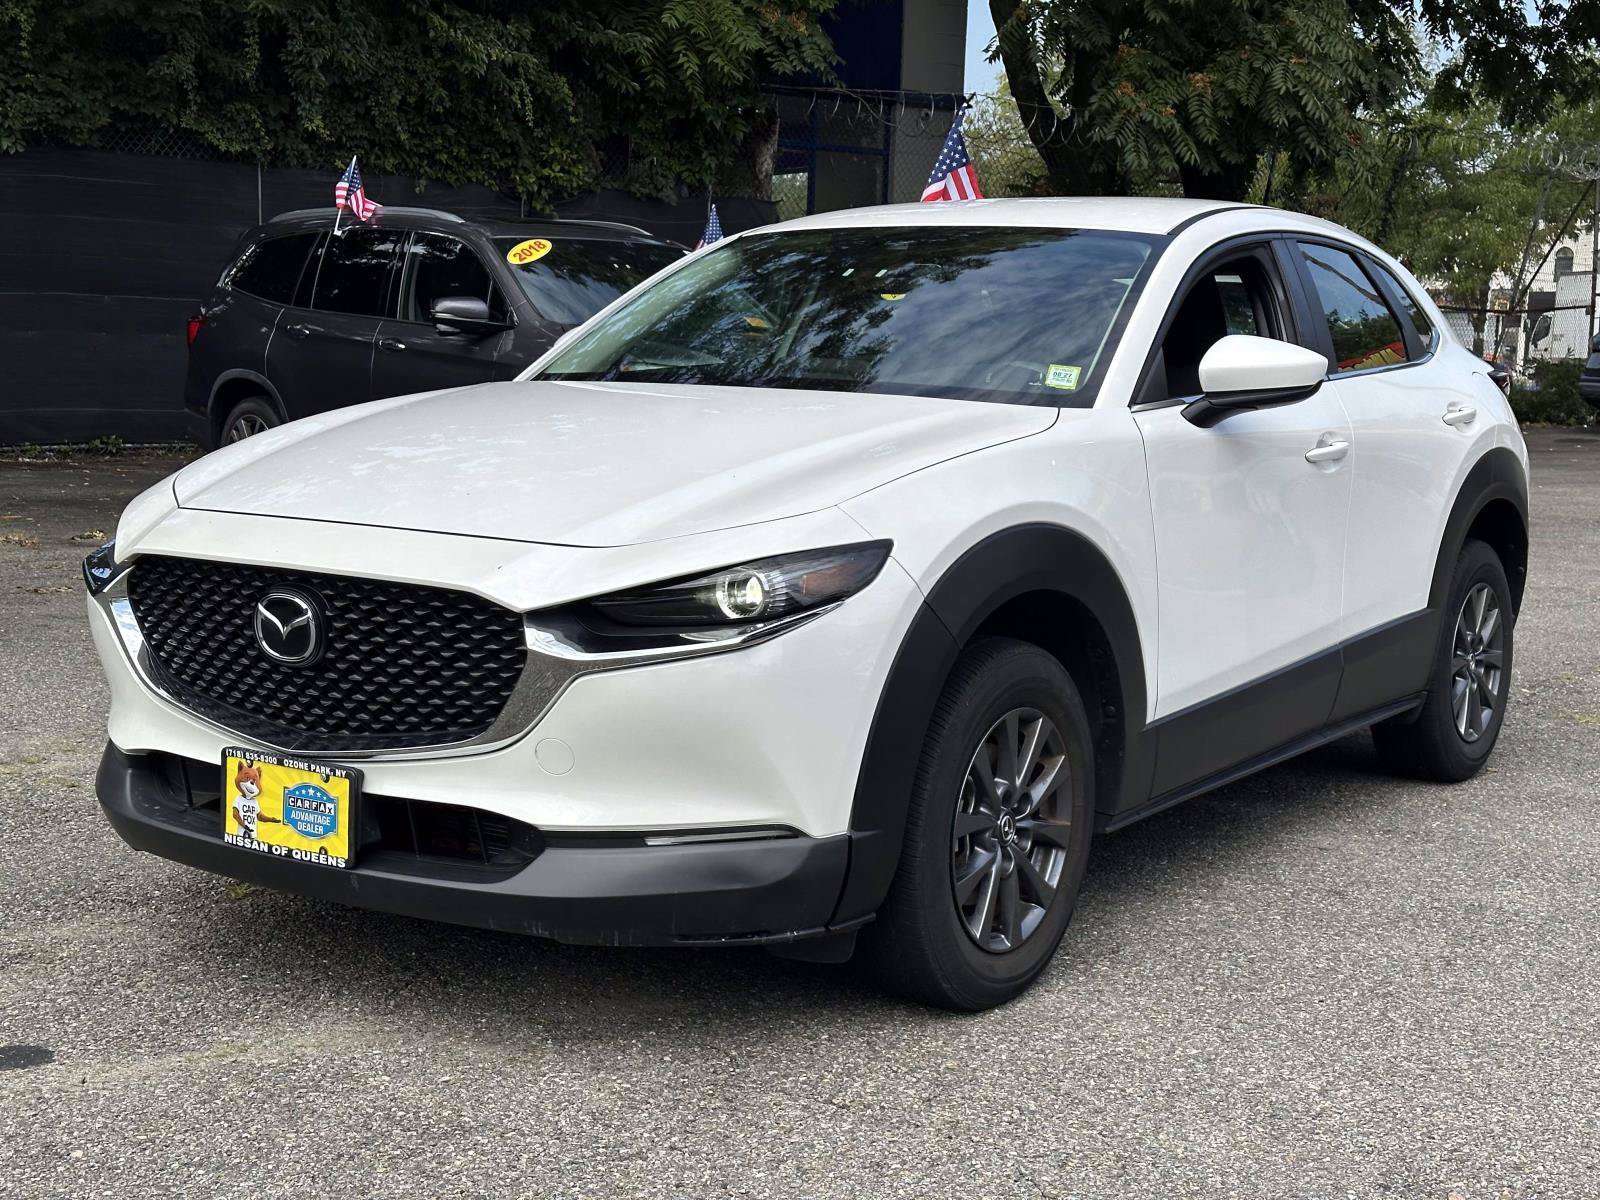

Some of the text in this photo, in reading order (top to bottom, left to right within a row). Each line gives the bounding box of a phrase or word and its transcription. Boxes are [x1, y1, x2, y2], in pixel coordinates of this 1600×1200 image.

[513, 241, 547, 262] 2018
[226, 748, 244, 759] (718)
[283, 759, 309, 771] OZONE
[335, 769, 347, 778] NY
[289, 797, 334, 815] CARFAX
[242, 814, 256, 825] FOX
[291, 810, 331, 826] ADVANTAGE
[297, 821, 324, 834] DEALER
[224, 833, 346, 868] NISSAN OF QUEENS
